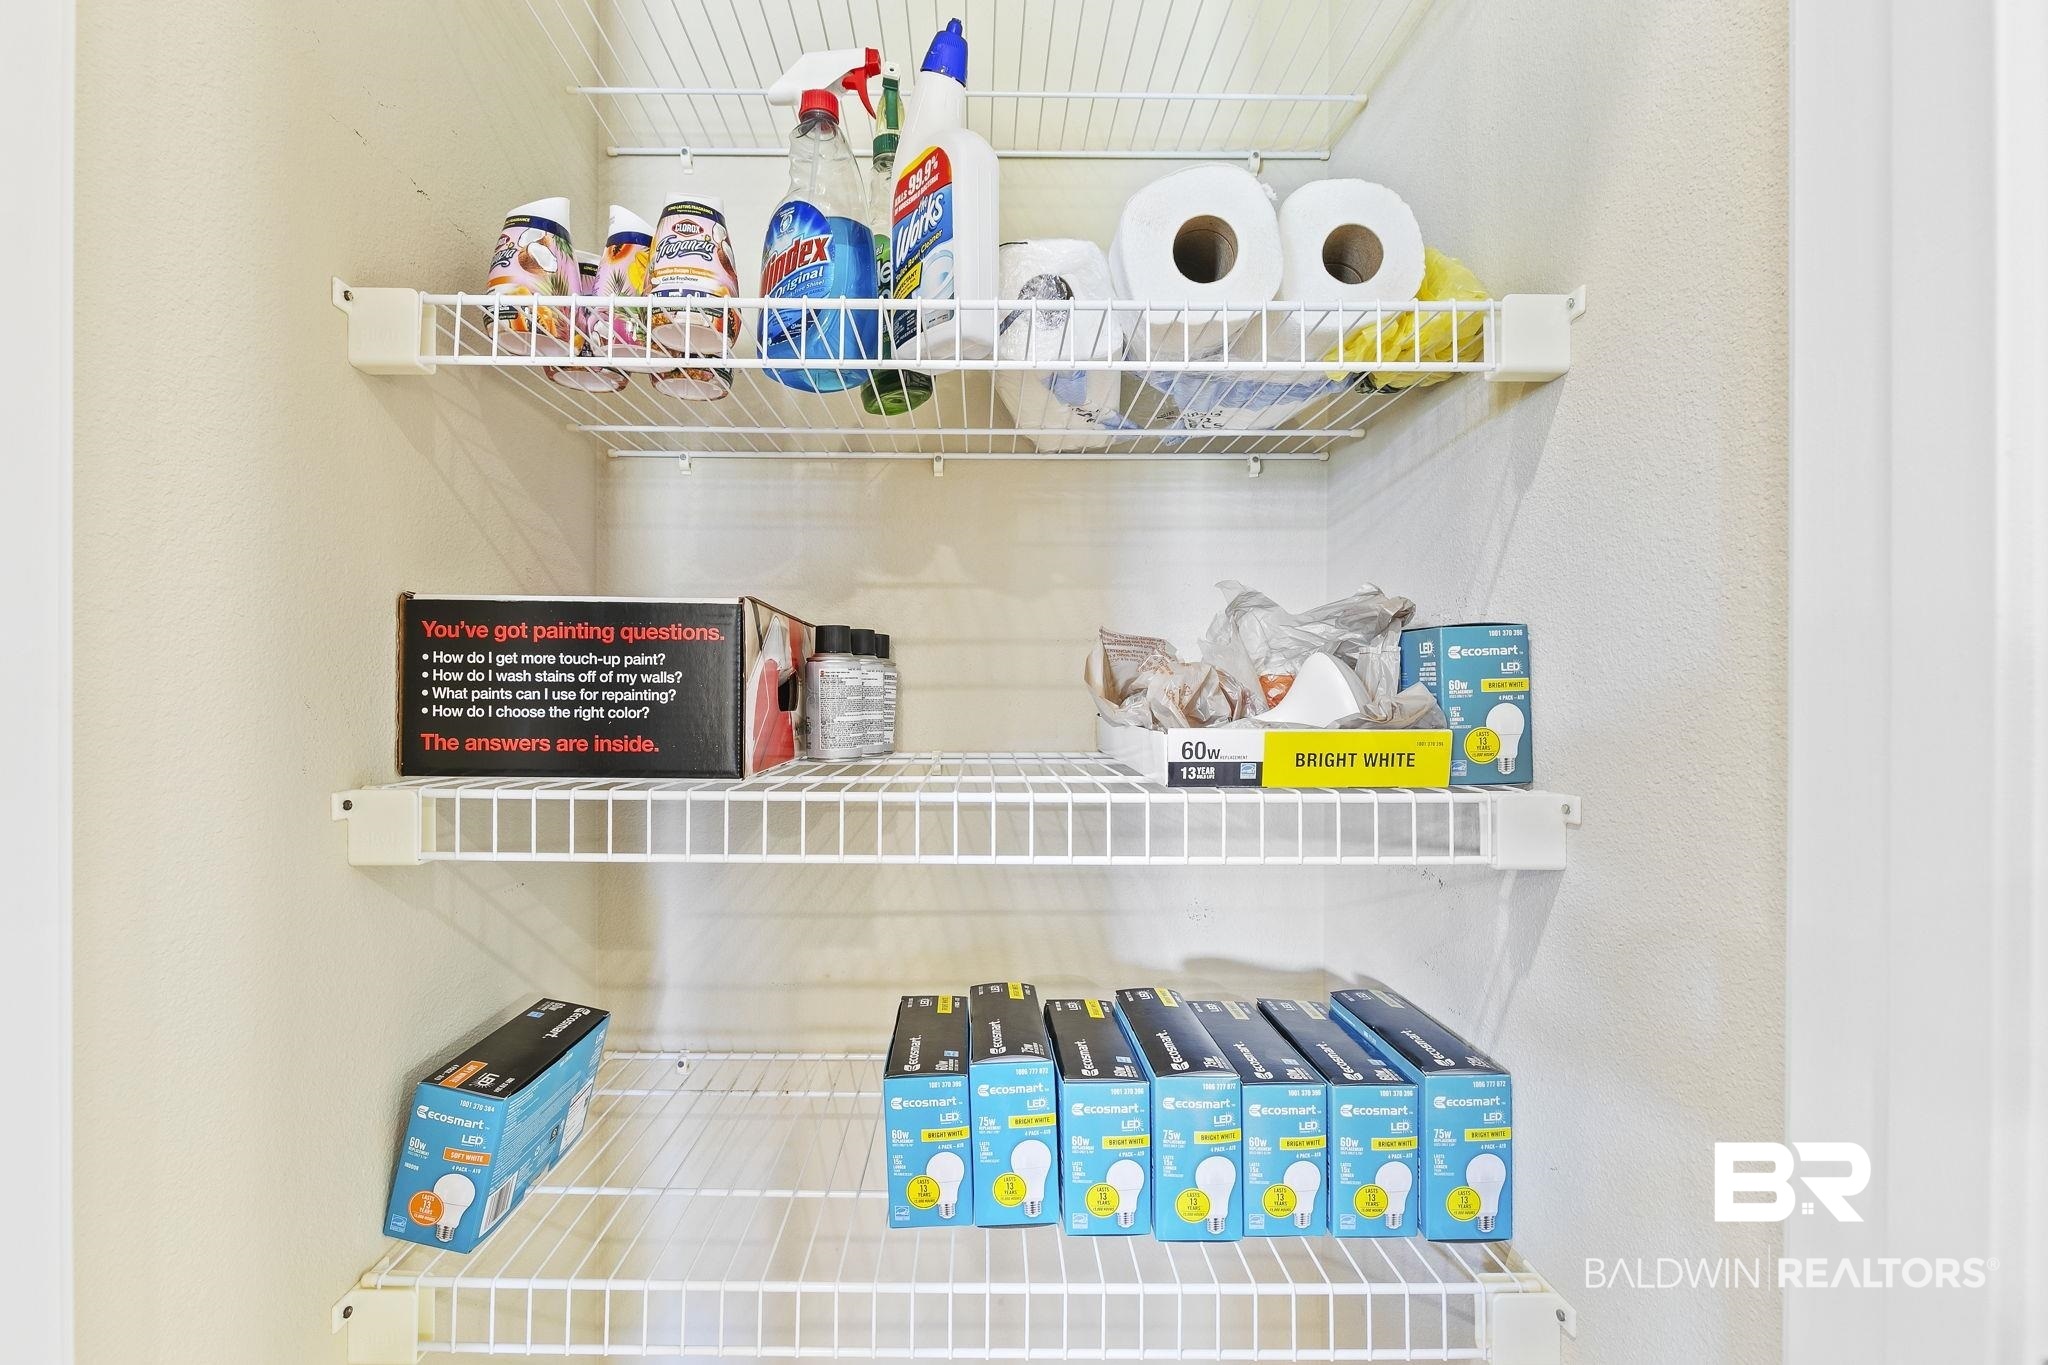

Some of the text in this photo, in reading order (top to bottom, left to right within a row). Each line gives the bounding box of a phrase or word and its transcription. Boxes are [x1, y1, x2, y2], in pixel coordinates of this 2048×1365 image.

[908, 153, 939, 196] 99.9%
[675, 223, 701, 234] CLOROX
[896, 193, 945, 269] Works
[656, 235, 715, 263] Fraganzia
[774, 266, 825, 299] Original
[422, 620, 725, 644] You've got painting questions.
[1502, 629, 1512, 637] 370
[1419, 642, 1433, 655] LED
[1462, 645, 1519, 657] ecosmart
[432, 650, 666, 668] How do I get more touch-up paint?
[1500, 661, 1521, 672] LED
[432, 668, 683, 686] How do I wash stains off of my walls?
[1448, 679, 1468, 691] 60w
[1488, 681, 1507, 689] BRIGHT
[431, 686, 677, 704] What paints can I use for repainting?
[432, 704, 650, 721] How do I choose the right color?
[420, 733, 660, 753] The answers are inside.
[1478, 737, 1488, 746] 13
[1181, 741, 1221, 760] 60w
[1295, 752, 1416, 768] BRIGHT WHITE
[1180, 766, 1197, 780] 13
[1196, 766, 1216, 775] YEAR
[989, 1084, 1044, 1097] ecosmart
[902, 1096, 957, 1108] ecosmart
[1026, 1098, 1047, 1108] LED
[1175, 1097, 1231, 1109] ecosmart
[1446, 1095, 1501, 1107] ecosmart
[1083, 1103, 1139, 1115] ecosmart
[1261, 1104, 1317, 1116] ecosmart
[1353, 1105, 1409, 1116] ecosmart
[428, 1109, 485, 1130] ecosmart
[939, 1112, 960, 1123] LED
[978, 1116, 996, 1127] 75w
[1014, 1116, 1050, 1125] BRIGHT WHITE
[1213, 1114, 1233, 1124] LED
[1483, 1112, 1503, 1122] LED
[1121, 1119, 1141, 1130] LED
[1299, 1121, 1318, 1131] LED
[1390, 1122, 1410, 1131] LED
[891, 1130, 909, 1140] 60w
[927, 1130, 963, 1139] BRIGHT WHITE
[1162, 1129, 1181, 1140] 75w
[1433, 1128, 1452, 1139] 75w
[408, 1136, 427, 1151] 60w
[461, 1134, 484, 1146] LED
[1071, 1136, 1090, 1146] 60w
[1108, 1138, 1127, 1146] BRIGHT
[1249, 1136, 1267, 1147] 60w
[1286, 1139, 1305, 1147] BRIGHT
[1340, 1137, 1359, 1147] 60w
[1378, 1139, 1413, 1148] BRIGHT WHITE
[450, 1151, 484, 1163] SOFT WHITE
[919, 1185, 929, 1193] 13
[1006, 1182, 1015, 1190] 13
[1099, 1192, 1108, 1200] 13
[1276, 1194, 1285, 1202] 13
[1367, 1194, 1376, 1202] 13
[1460, 1196, 1469, 1204] 13
[422, 1200, 432, 1210] 13
[1189, 1198, 1198, 1206] 13
